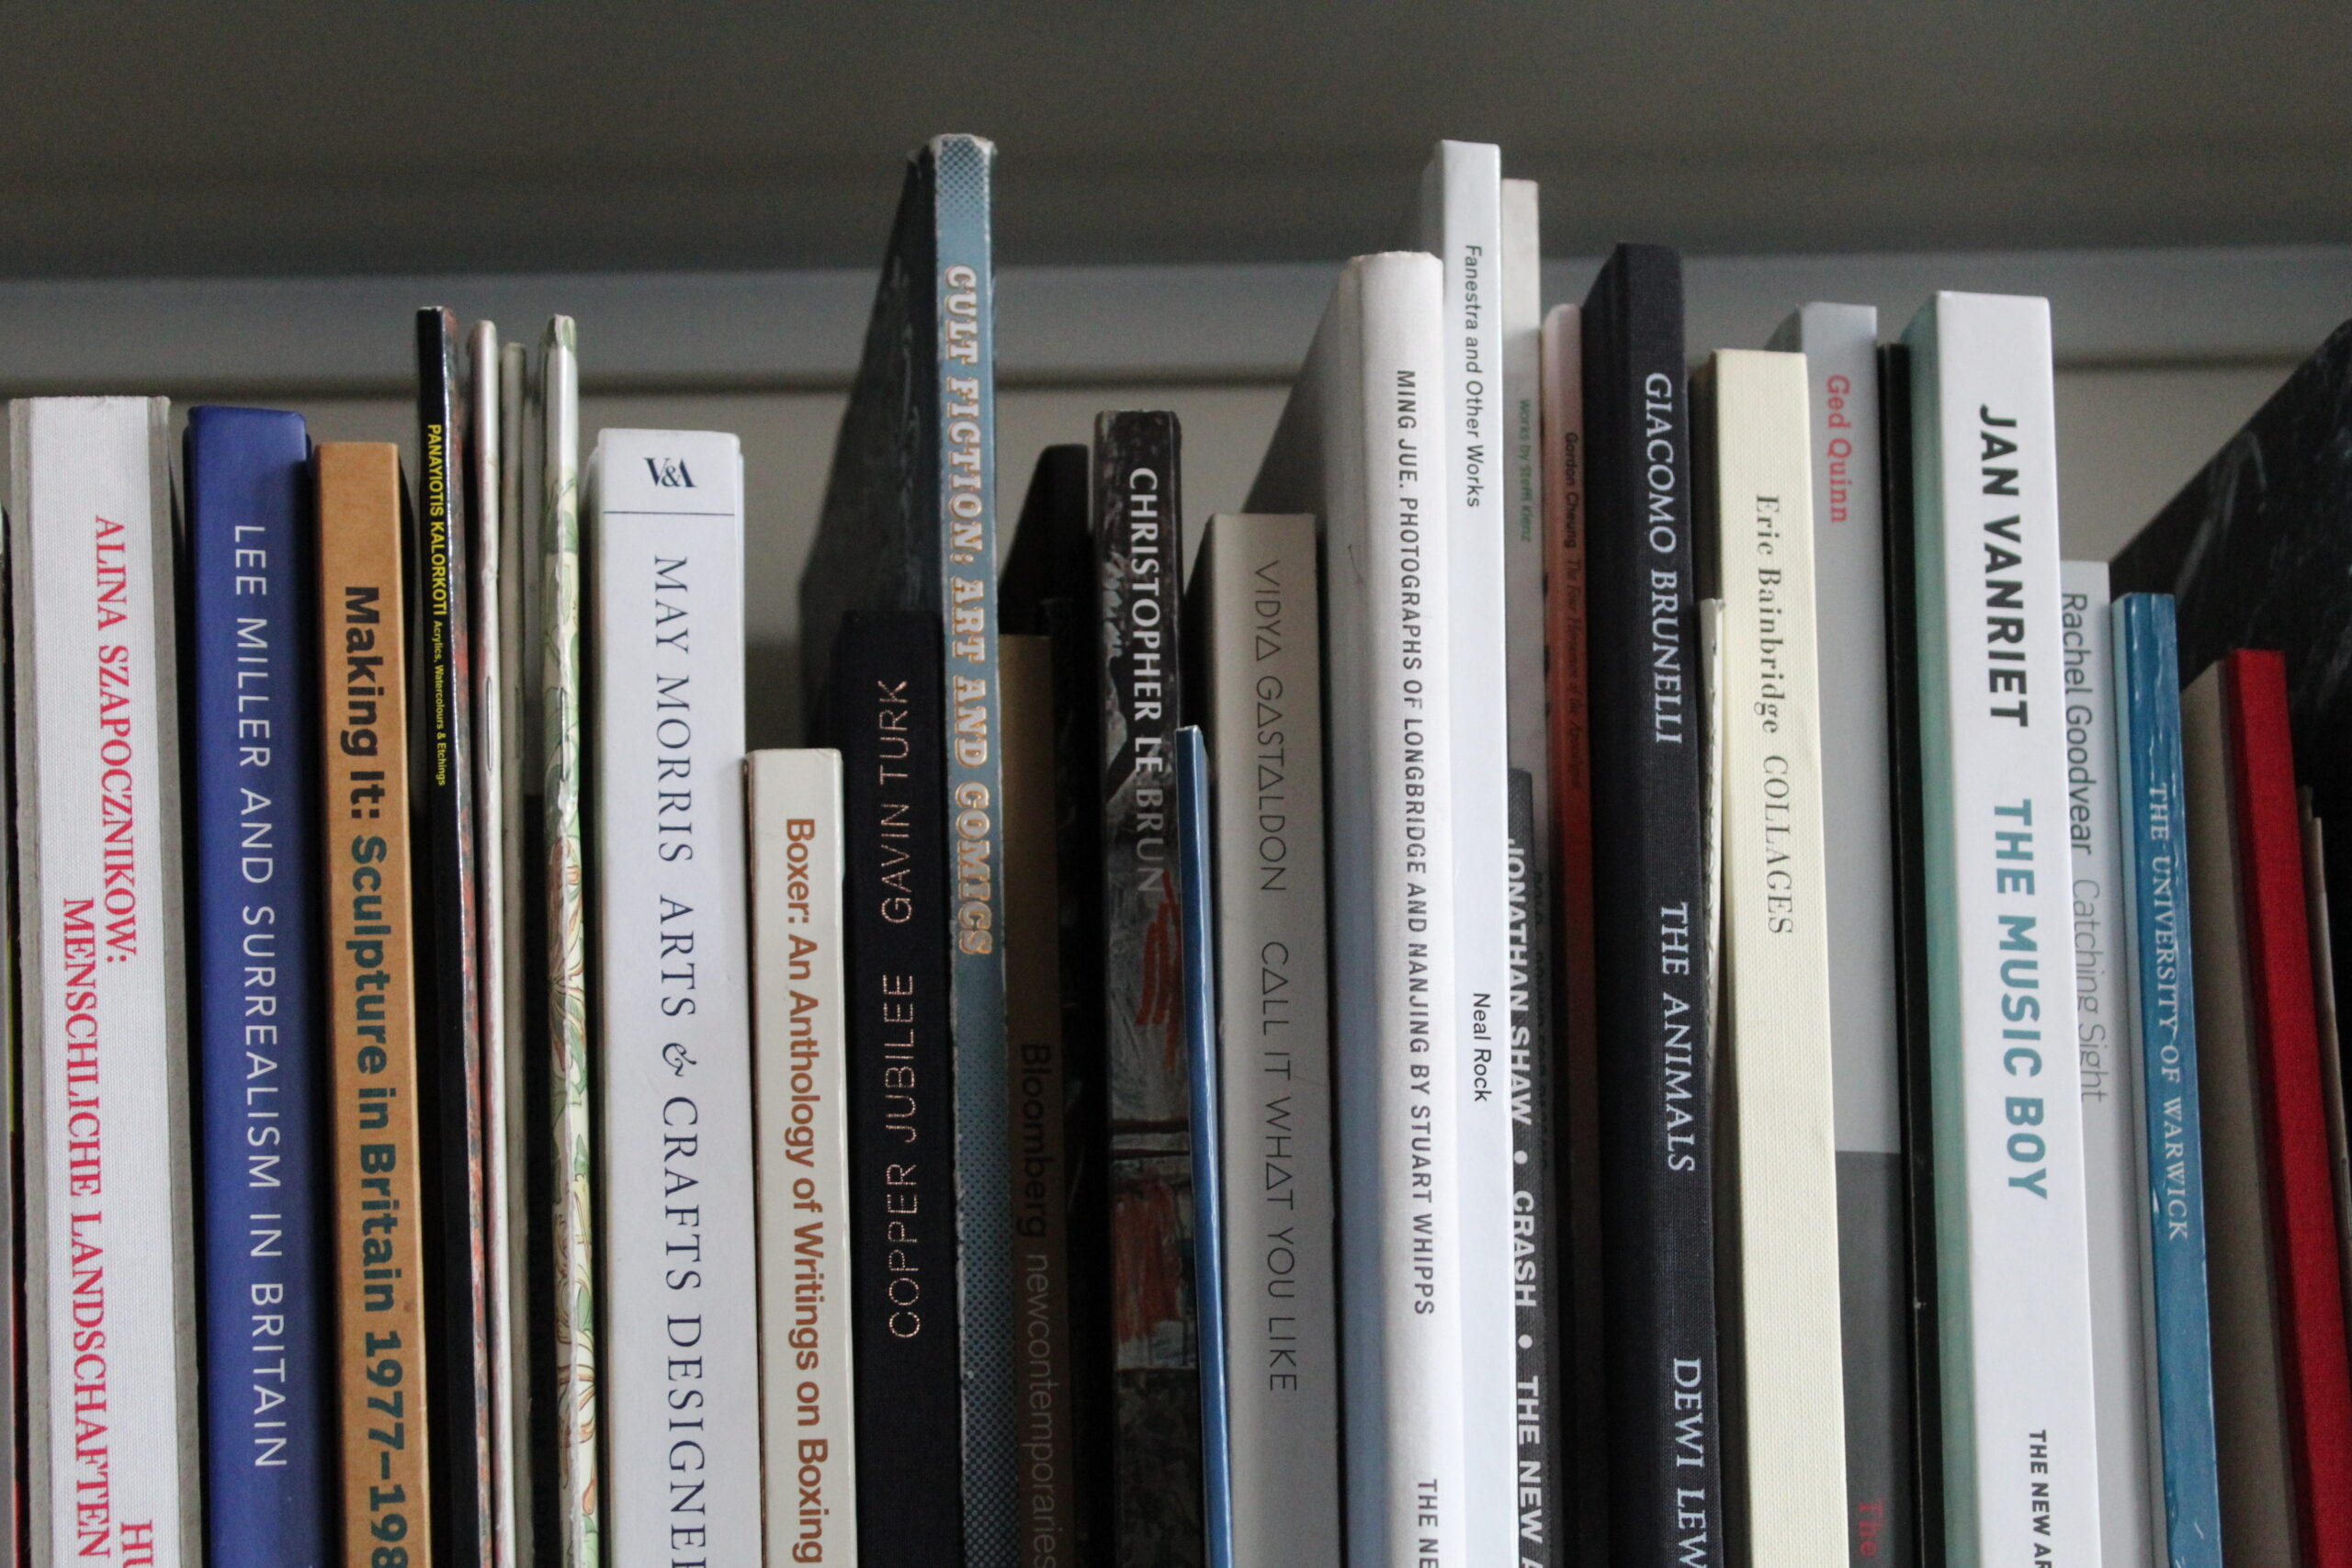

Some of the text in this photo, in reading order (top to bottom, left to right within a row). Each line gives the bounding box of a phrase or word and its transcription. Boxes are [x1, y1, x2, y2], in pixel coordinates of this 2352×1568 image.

[643, 457, 696, 489] V&A
[1464, 245, 1485, 508] Fanestra and Other Works
[1565, 431, 1581, 549] Gordon Cheung
[1826, 375, 1852, 524] Ged Quinn
[427, 424, 448, 615] PANAYIOTIS KALORKOTI
[944, 265, 993, 955] CULT FICTION: ART AND COMICS
[1645, 372, 1683, 744] GIACOMO BRUNELLI
[1979, 403, 2029, 728] JAN VANRIET
[95, 515, 138, 964] ALINA SZAPOCZNIKOW:
[340, 586, 389, 820] Making It:
[434, 664, 447, 727] Watercolours
[435, 741, 447, 786] Etchings
[436, 728, 446, 739] &
[654, 555, 694, 863] MAY MORRIS
[1128, 467, 1165, 893] CHRISTOPHER LE BRUN
[1255, 559, 1287, 892] VIDYA GASTALDON
[1753, 494, 1793, 934] Eric Bainbridge COLLAGES
[2061, 592, 2098, 856] Rachel Goodyear
[876, 679, 914, 924] GAVIN TURK
[1396, 370, 1435, 1314] MING JUE. PHOTOGRAPHS OF LONGBRIDGE AND NANJING BY STUART WHIPPS
[234, 525, 288, 1467] LEE MILLER AND SURREALISM IN BRITAIN
[345, 835, 392, 1075] Sculpture
[659, 894, 696, 1017] ARTS
[662, 1042, 697, 1077] &
[1472, 992, 1493, 1102] Neal Rock
[1508, 838, 1532, 1125] JONATHAN SHAW
[1660, 902, 1696, 1172] THE ANIMALS
[1994, 798, 2048, 1200] THE MUSIC BOY
[2072, 878, 2109, 1103] Catching Sight
[2149, 783, 2188, 1242] THE UNIVERSITY OF WARWICK
[63, 897, 111, 1558] MENSCHLICHE LANDSCHAFTEN
[358, 1088, 397, 1130] in
[662, 1096, 703, 1291] CRAFTS
[784, 818, 830, 1564] Boxer: An Anthology of Writings on Boxing
[882, 975, 921, 1338] COPPER JUBILEE
[1261, 942, 1297, 1392] CALL IT WHAT YOU LIKE
[359, 1144, 402, 1313] Britain
[1016, 1043, 1064, 1568] Bloomberg newcontemporaries
[1513, 1190, 1537, 1307] CRASH
[1418, 1479, 1438, 1527] THE
[1517, 1376, 1540, 1445] THE
[1519, 1461, 1544, 1544] NEW
[1673, 1358, 1705, 1469] DEWI
[1858, 1498, 1884, 1557] The
[2029, 1429, 2049, 1474] THE
[2030, 1482, 2051, 1536] NEW
